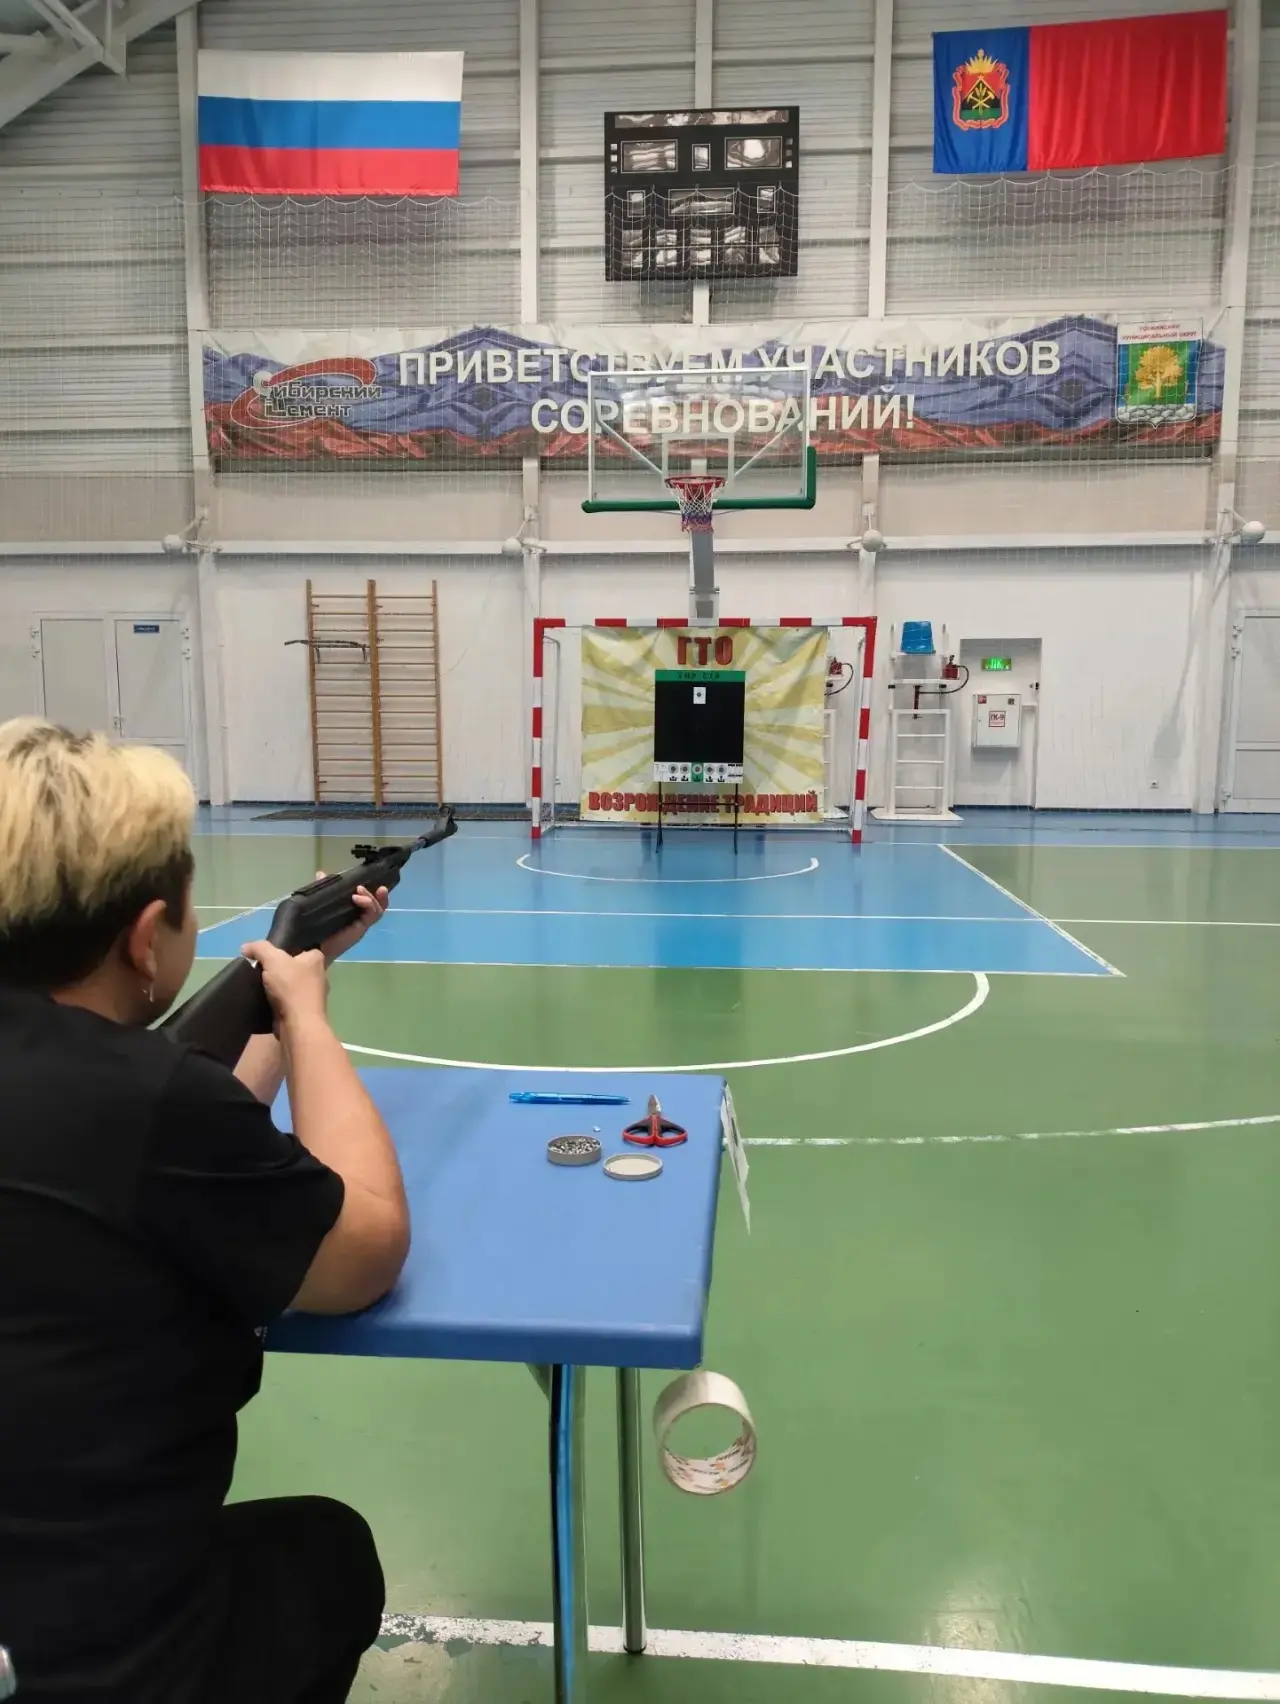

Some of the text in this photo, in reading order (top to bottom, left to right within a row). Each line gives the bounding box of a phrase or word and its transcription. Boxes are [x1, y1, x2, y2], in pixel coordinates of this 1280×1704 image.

[399, 340, 1061, 386] ПРИВЕТСТВУЕМ УЧАСТНИКОВ
[531, 385, 916, 435] СОРЕВНОВАНИЙ!
[676, 635, 734, 666] ГТО
[588, 790, 818, 816] ВОЗРОЖДЕНИЕ ТРАДИЦИЙ
